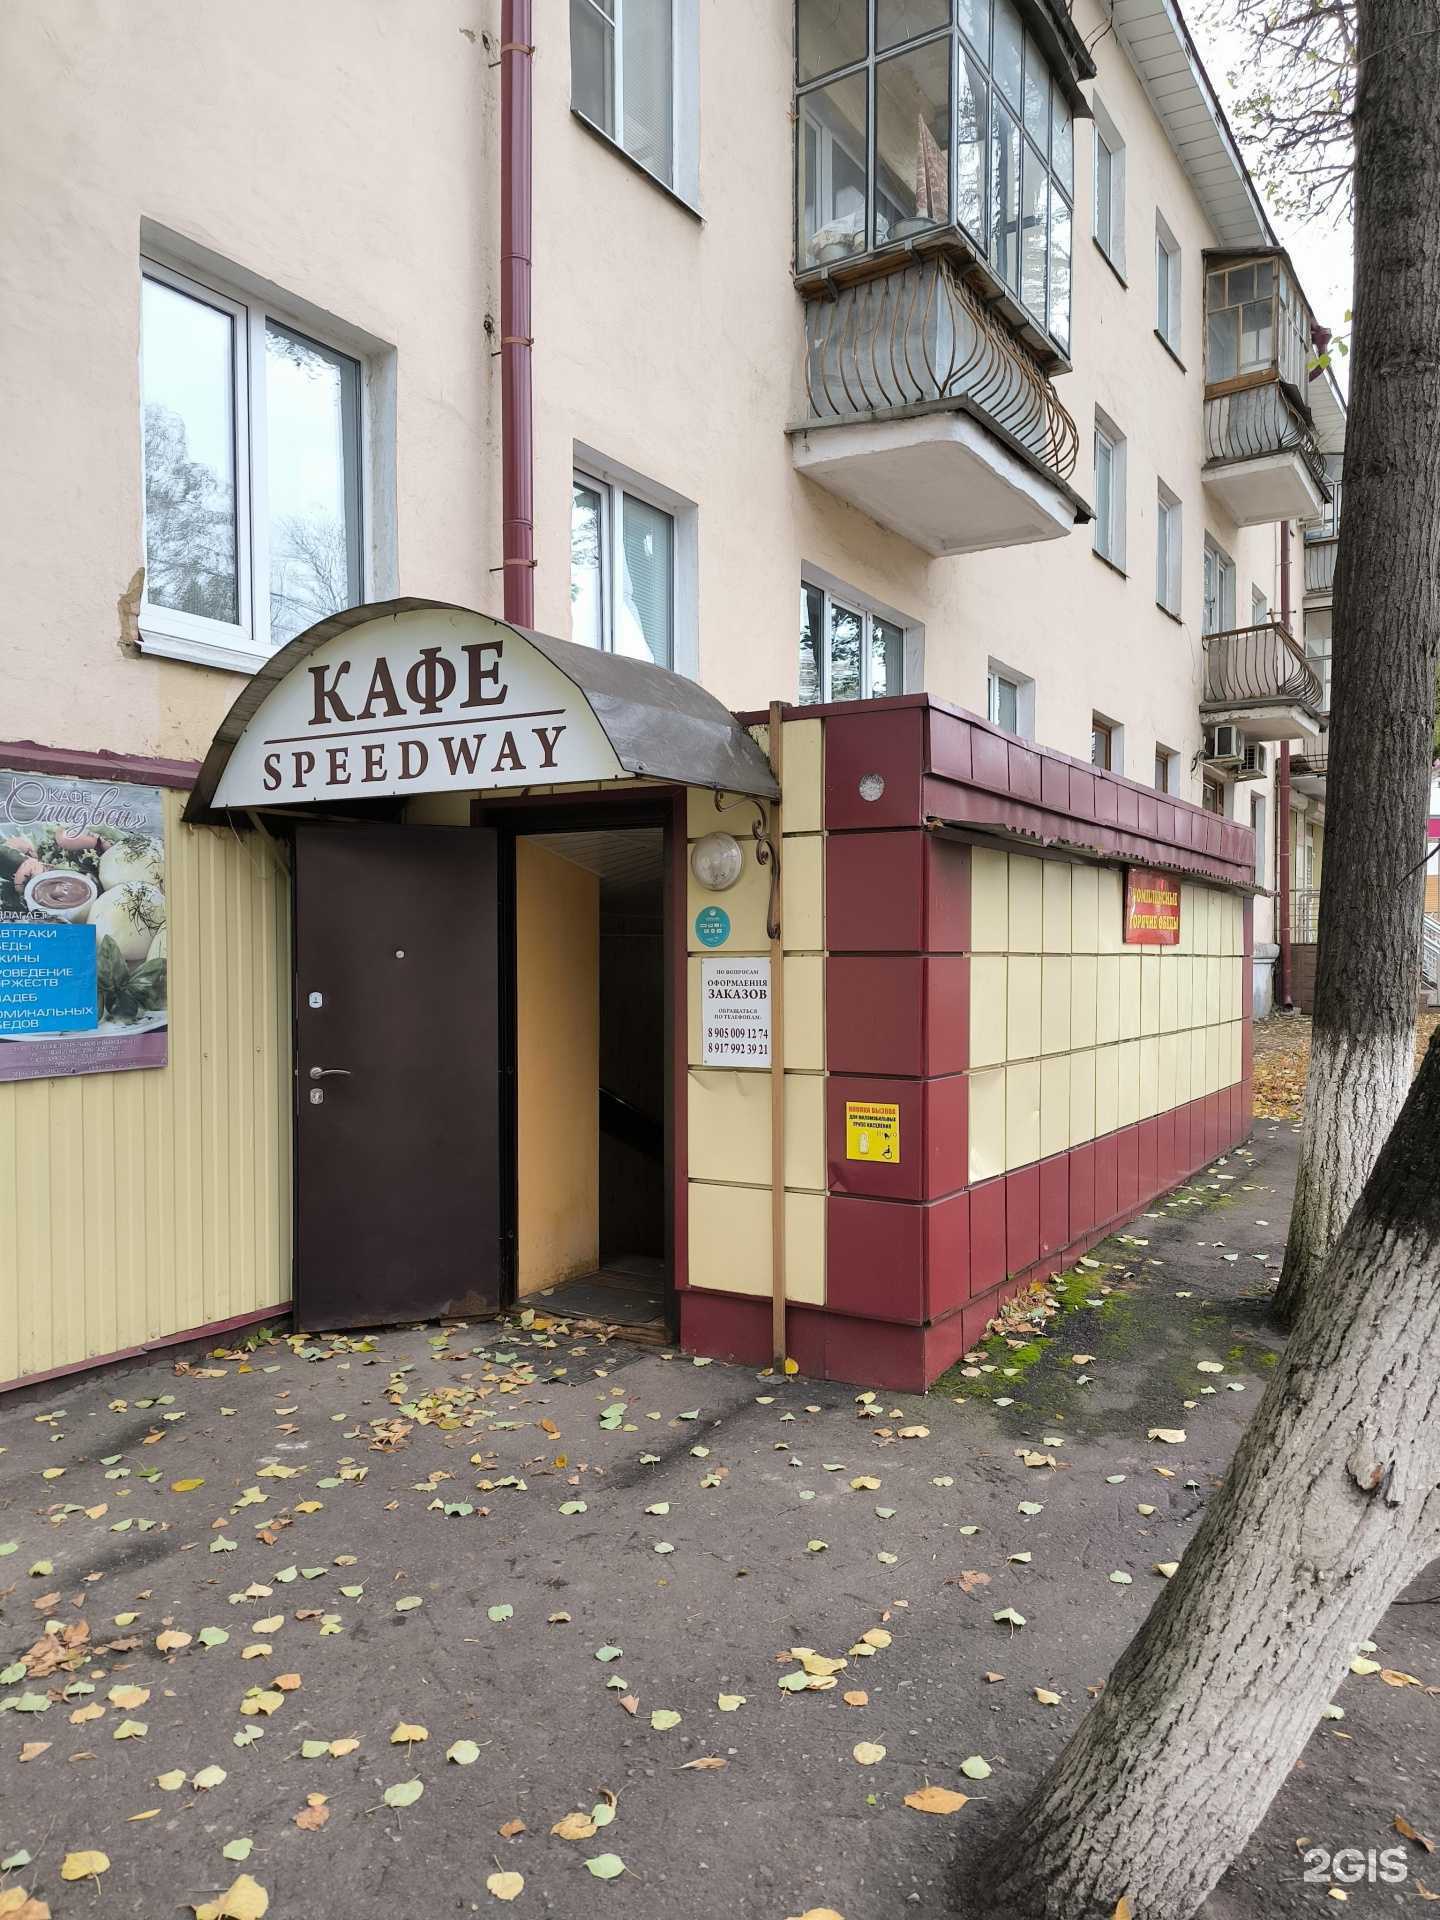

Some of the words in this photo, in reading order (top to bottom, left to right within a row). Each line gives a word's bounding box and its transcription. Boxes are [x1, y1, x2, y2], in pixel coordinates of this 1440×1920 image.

[308, 640, 508, 725] КАФЕ
[263, 726, 567, 791] SPEEDWAY
[48, 788, 92, 805] КАФЕ
[0, 929, 57, 938] ВТРАКИ
[0, 941, 32, 952] ЕДЫ
[0, 978, 58, 988] РЖЕСТВ
[707, 979, 768, 987] ОФОРМЛЕНИЯ
[0, 993, 38, 1003] АДЕБ
[708, 988, 767, 999] ЗАКАЗОВ
[0, 1019, 39, 1030] ЕДОВ
[708, 1027, 713, 1038] 8
[714, 1027, 729, 1038] 905
[730, 1027, 745, 1038] 009
[758, 1028, 769, 1039] 74
[714, 1043, 729, 1053] 917
[730, 1043, 745, 1054] 992
[747, 1043, 757, 1055] 39
[758, 1044, 768, 1055] 21
